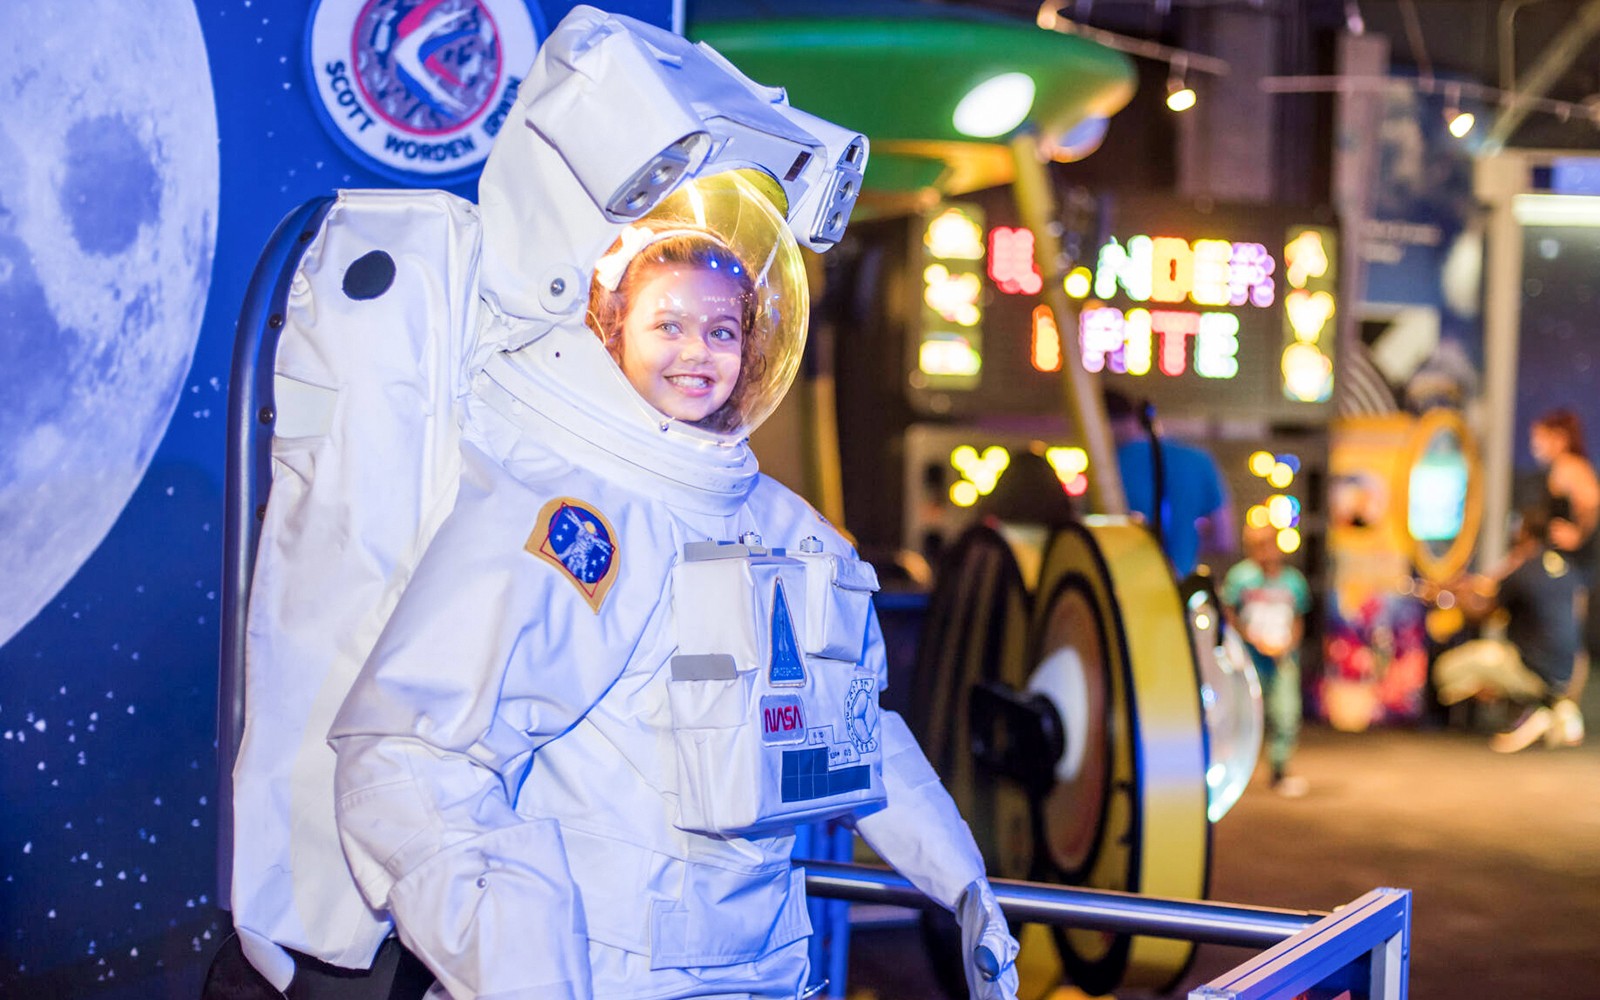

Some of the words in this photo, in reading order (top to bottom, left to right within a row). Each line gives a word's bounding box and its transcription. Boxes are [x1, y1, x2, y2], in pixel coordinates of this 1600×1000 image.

[325, 60, 376, 132] SCOTT
[384, 133, 477, 163] WORDEN
[764, 704, 804, 734] NASA
